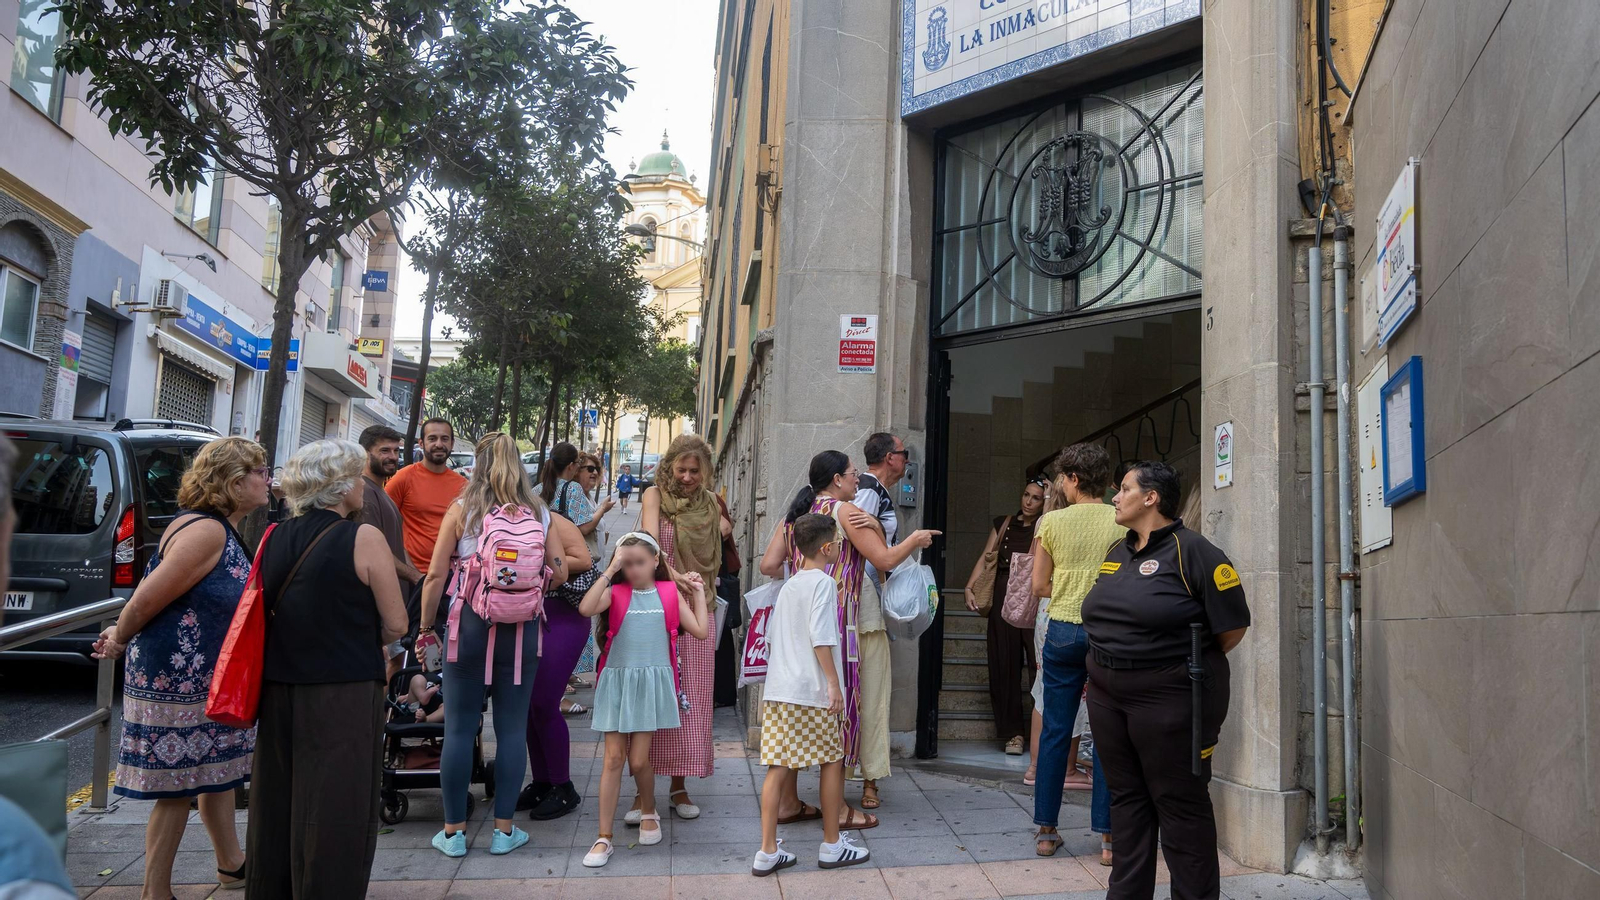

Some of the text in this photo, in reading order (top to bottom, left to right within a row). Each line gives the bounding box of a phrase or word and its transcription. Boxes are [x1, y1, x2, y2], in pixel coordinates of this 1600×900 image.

[959, 0, 1098, 53] LA INMACUL
[1218, 577, 1238, 588] PROSEGUR
